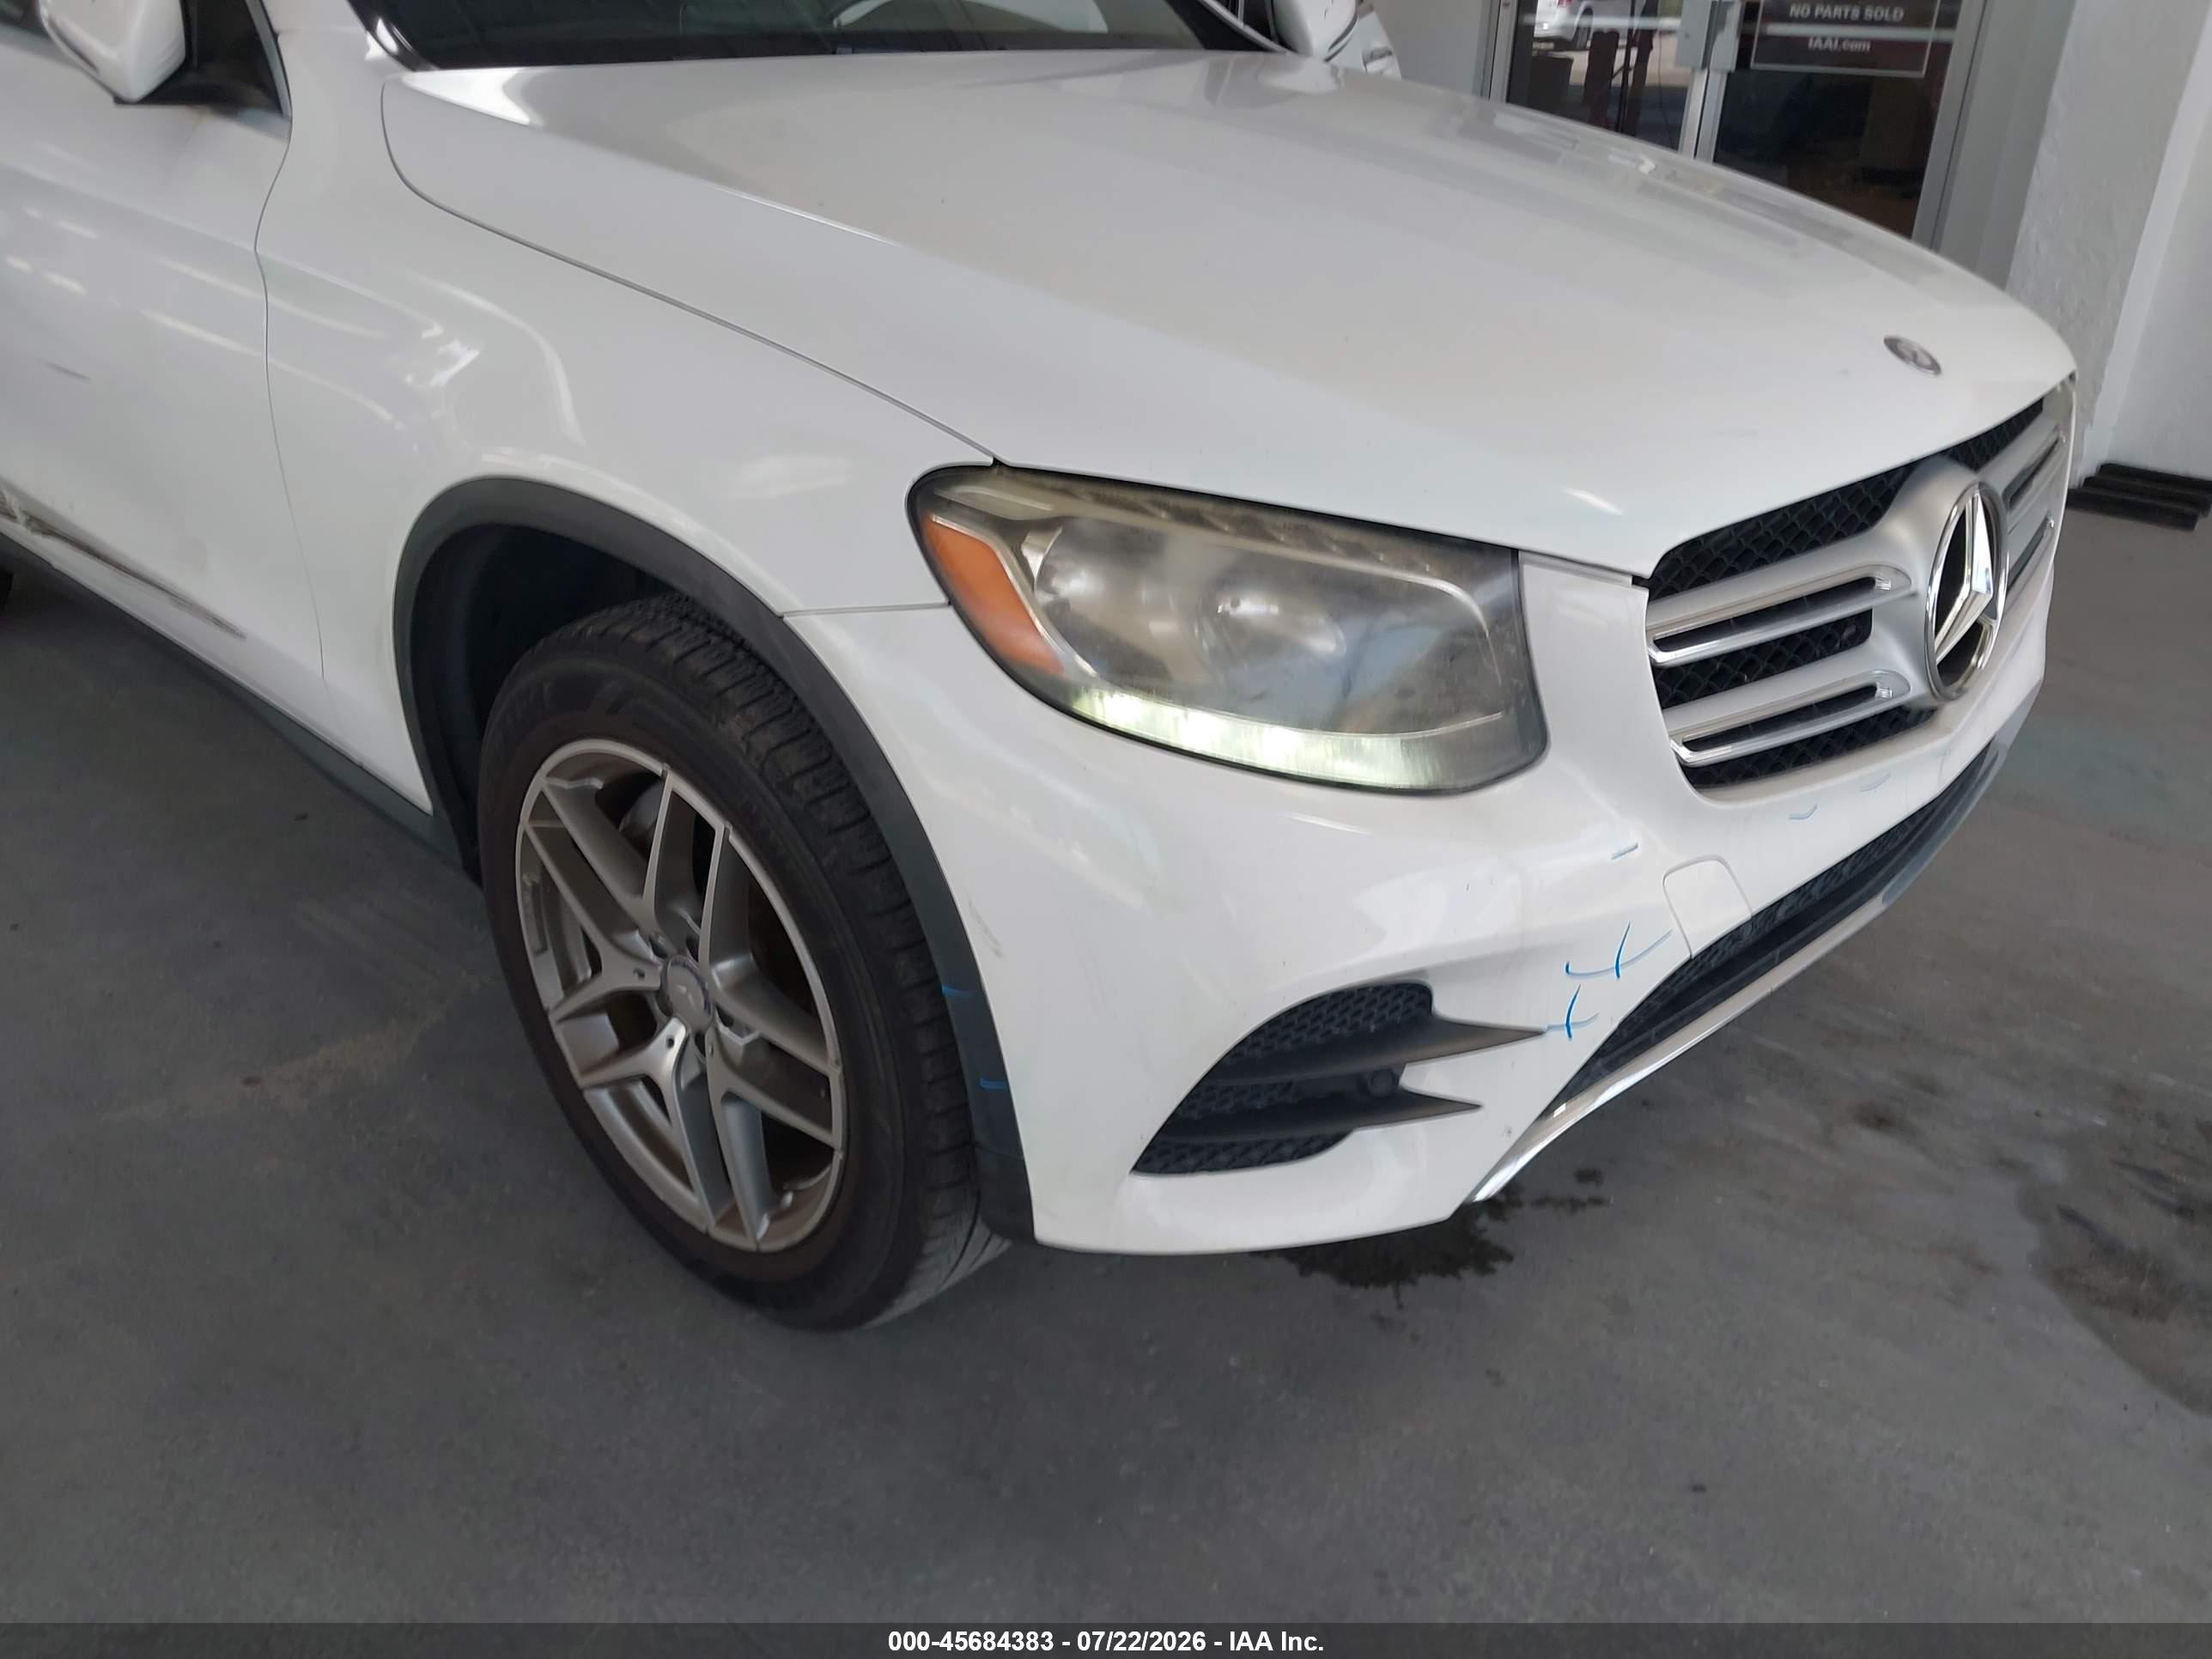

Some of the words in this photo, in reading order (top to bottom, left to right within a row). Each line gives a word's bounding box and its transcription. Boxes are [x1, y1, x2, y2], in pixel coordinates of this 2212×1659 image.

[1790, 3, 1810, 18] NO
[1814, 4, 1860, 20] PARTS
[1863, 6, 1904, 21] SOLD
[1808, 37, 1871, 52] IAAI.com
